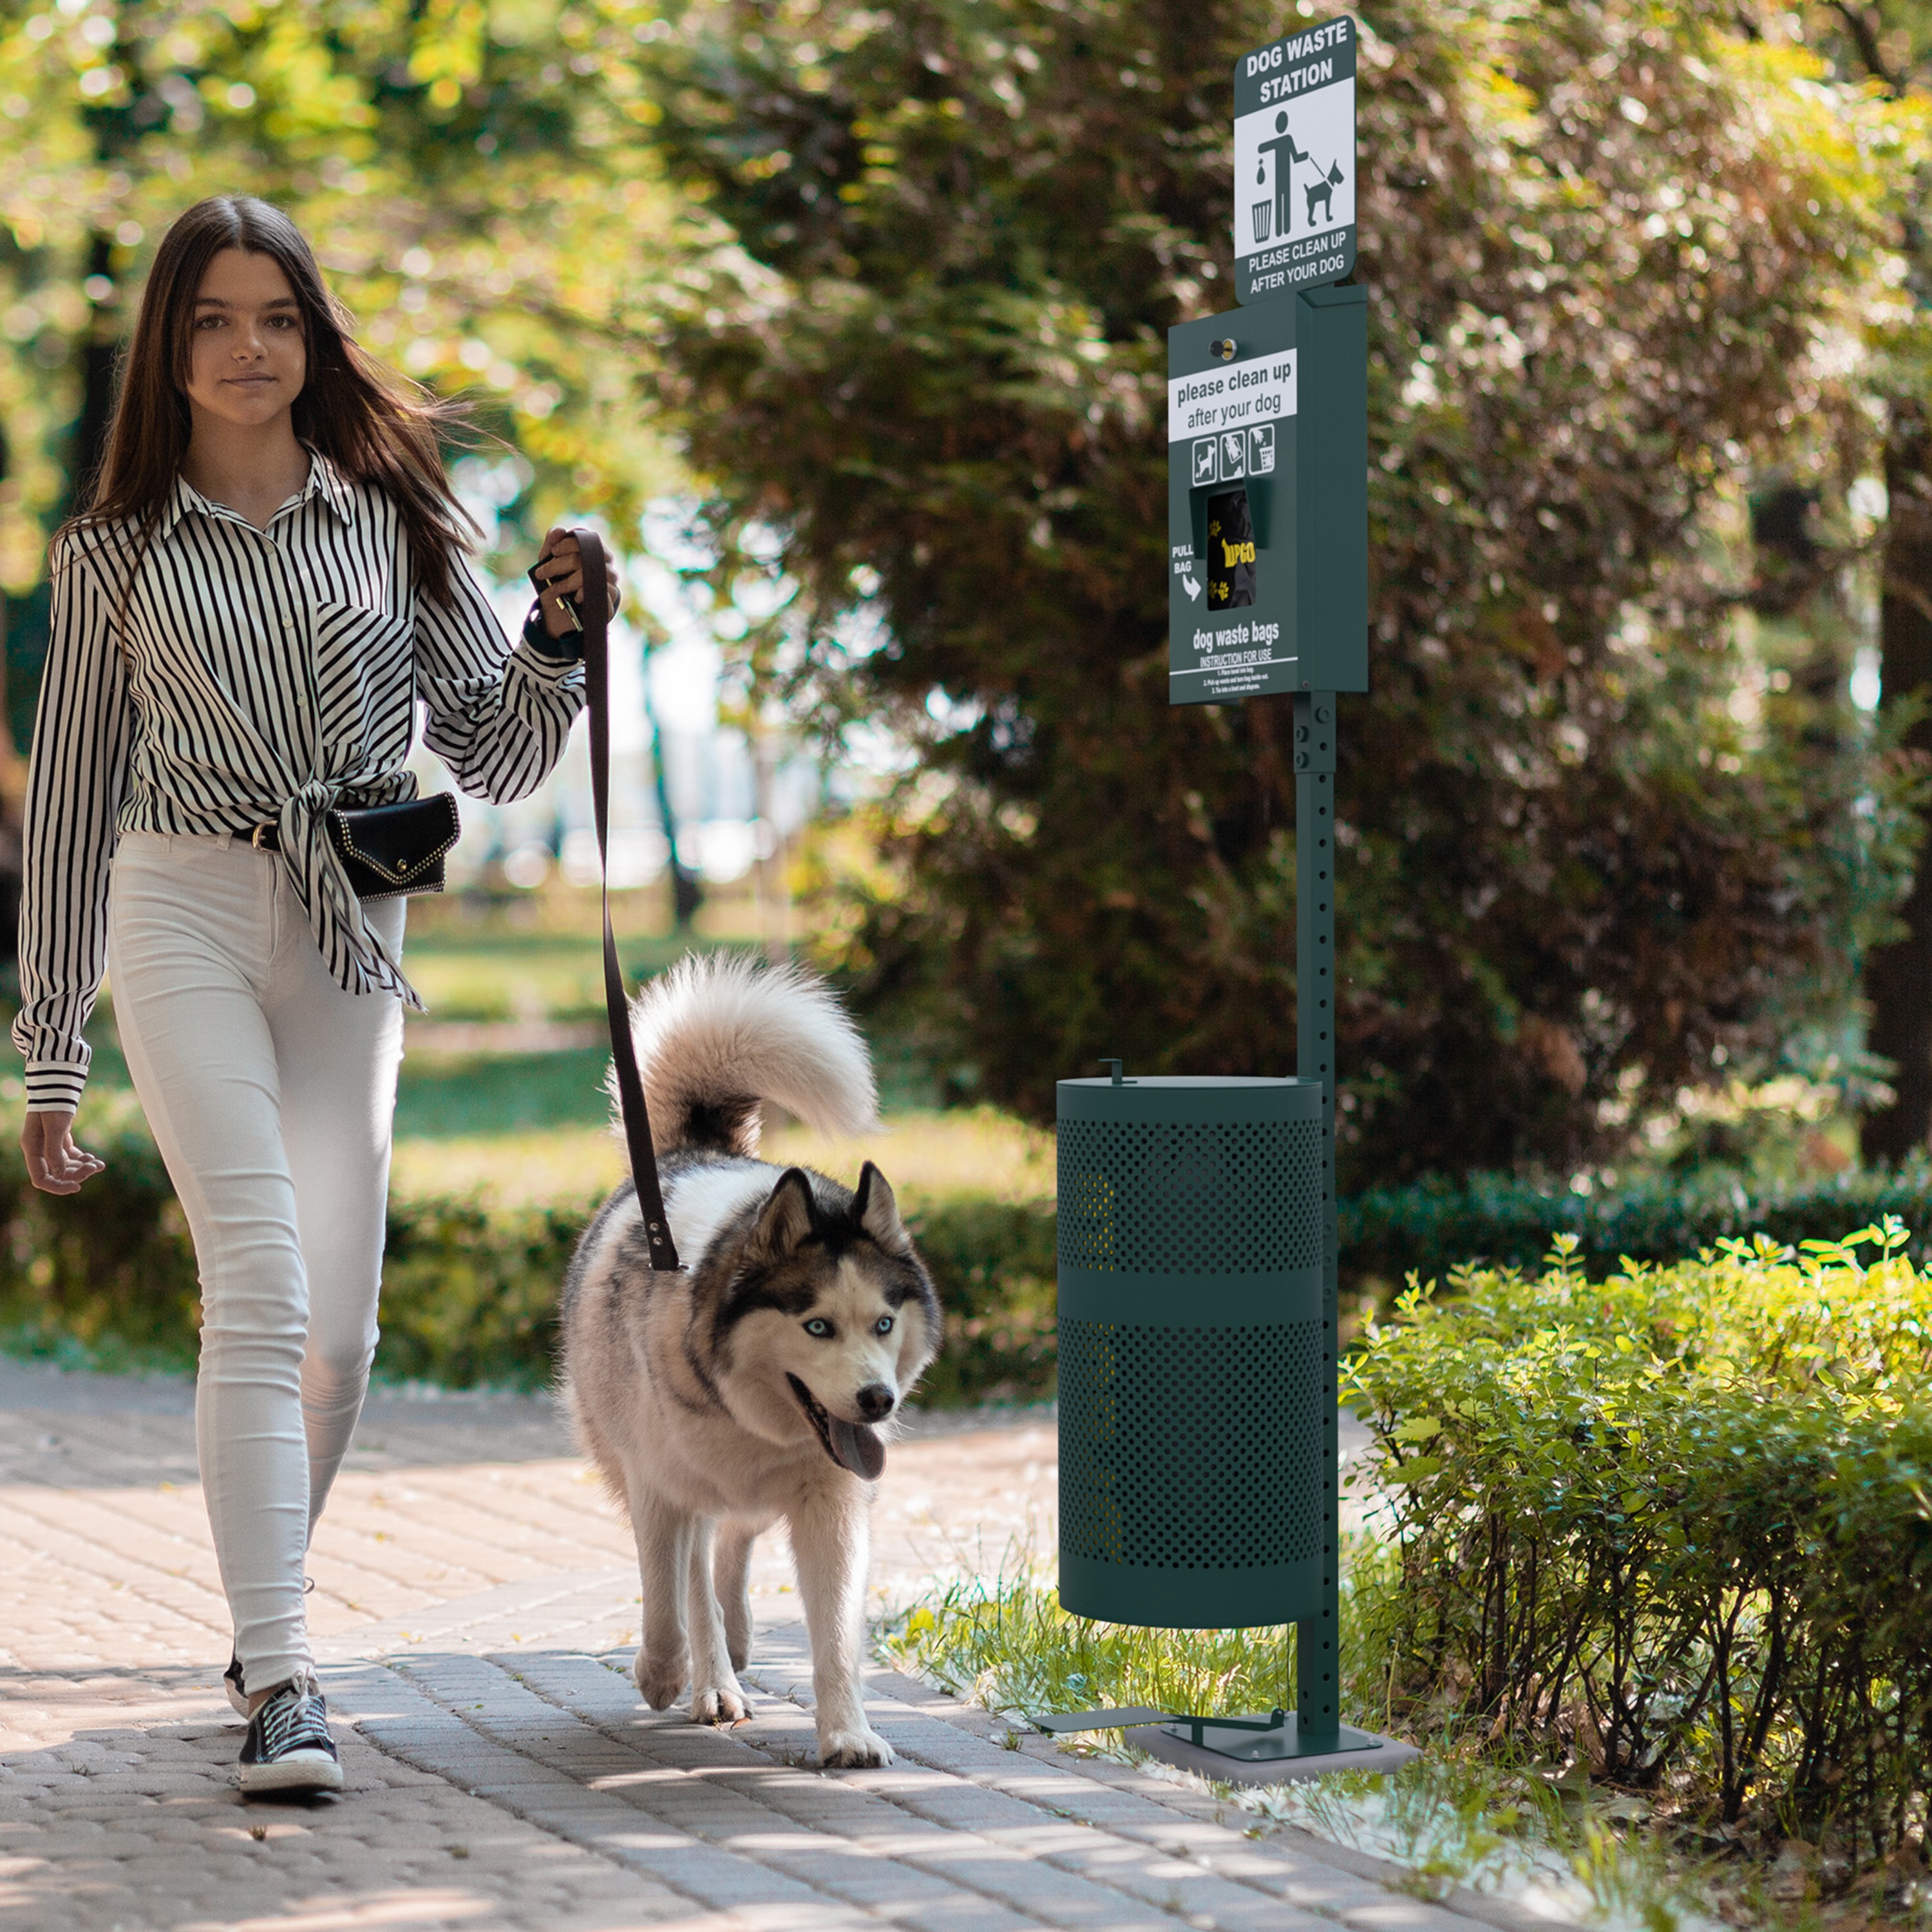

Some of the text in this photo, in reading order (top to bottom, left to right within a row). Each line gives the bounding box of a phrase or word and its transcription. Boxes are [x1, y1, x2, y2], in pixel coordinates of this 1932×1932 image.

[1247, 20, 1347, 77] DOG WASTE
[1260, 58, 1332, 103] STATION
[1249, 231, 1346, 273] PLEASE CLEAN UP
[1250, 254, 1344, 294] AFTER YOUR DOG
[1178, 363, 1291, 408] please clean up
[1188, 393, 1281, 428] after your dog
[1172, 544, 1194, 558] PULL
[1174, 560, 1191, 574] BAG
[1193, 620, 1280, 653] dog waste bags
[1200, 648, 1272, 668] INSTRUCTION FOR USE
